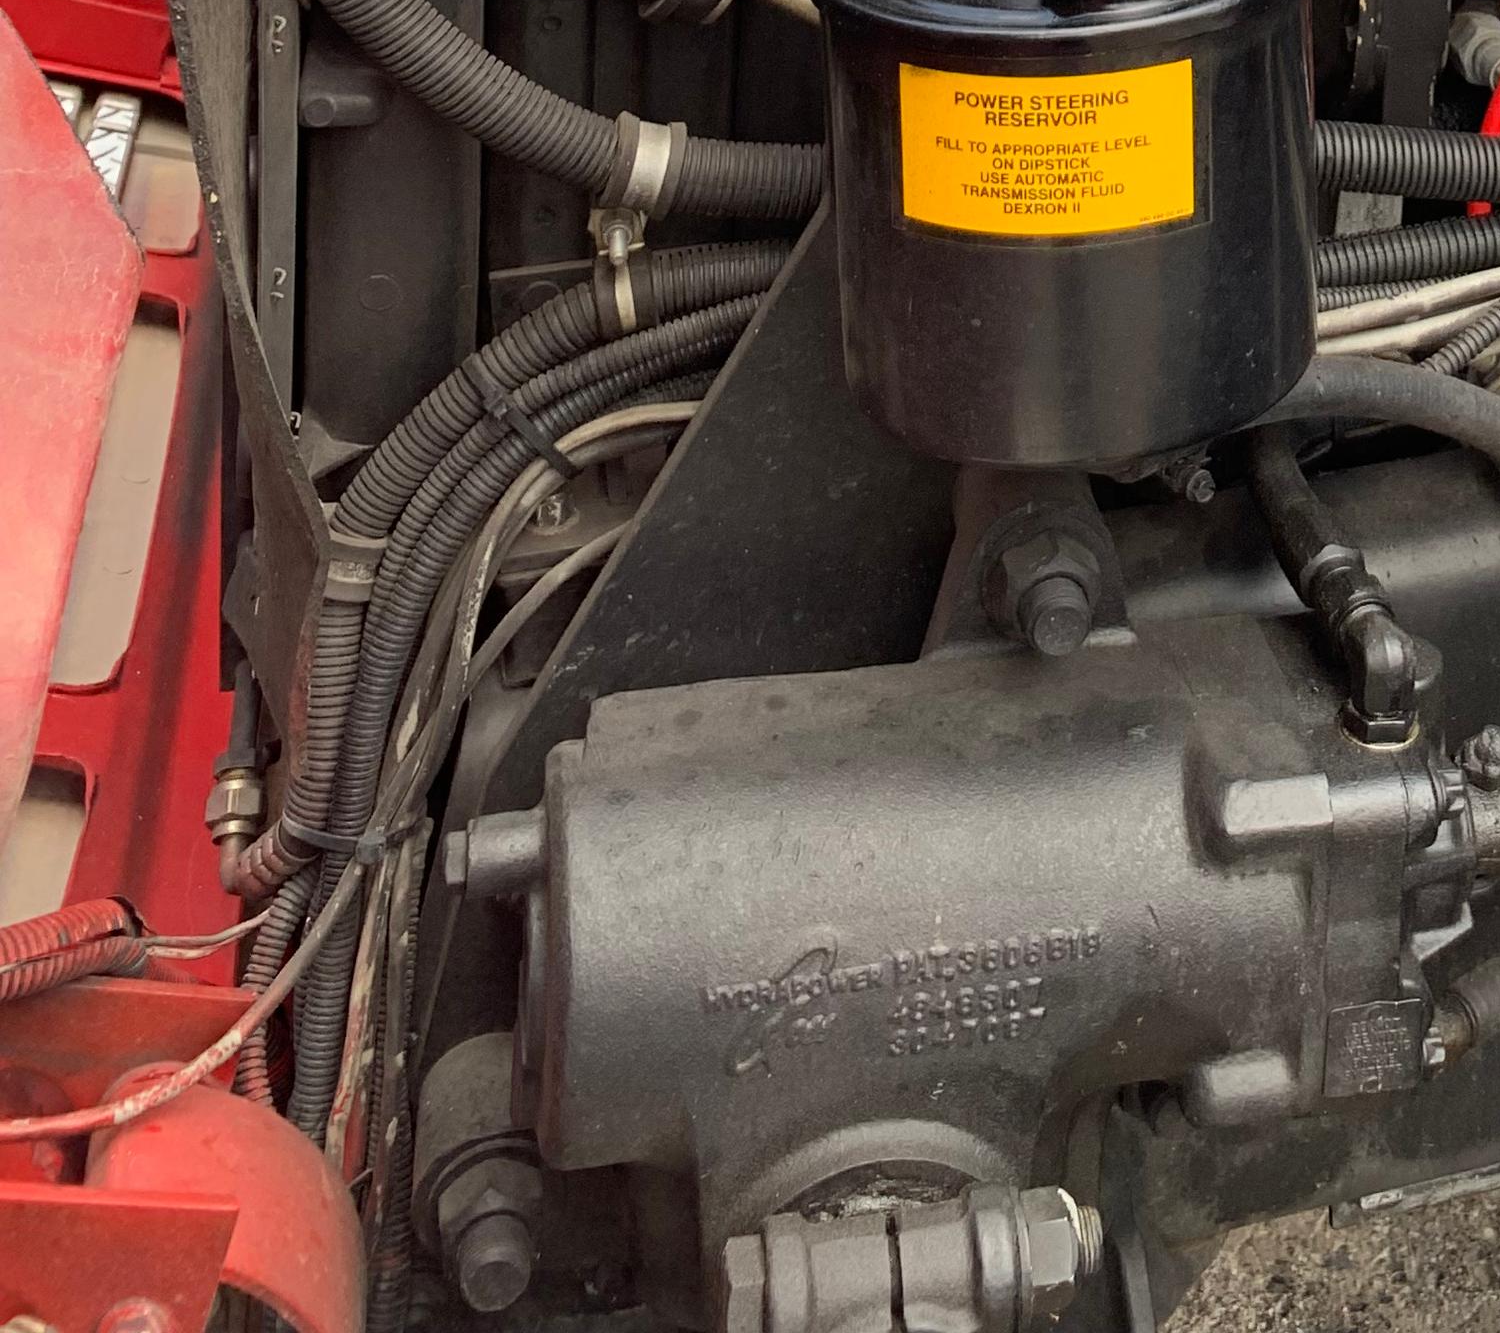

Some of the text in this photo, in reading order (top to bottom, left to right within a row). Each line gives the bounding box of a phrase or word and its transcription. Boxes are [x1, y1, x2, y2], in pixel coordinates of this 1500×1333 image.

[954, 90, 1130, 111] POWER STEERING
[984, 110, 1098, 128] RESERVOIR
[935, 134, 1152, 157] FILL TO APPROPRIATE LEVEL
[992, 157, 1091, 171] ON DIPSTICK
[980, 170, 1105, 186] USE AUTOMATIC
[961, 183, 1125, 201] TRANSMISSION FLUID
[1003, 202, 1081, 215] DEXRON II
